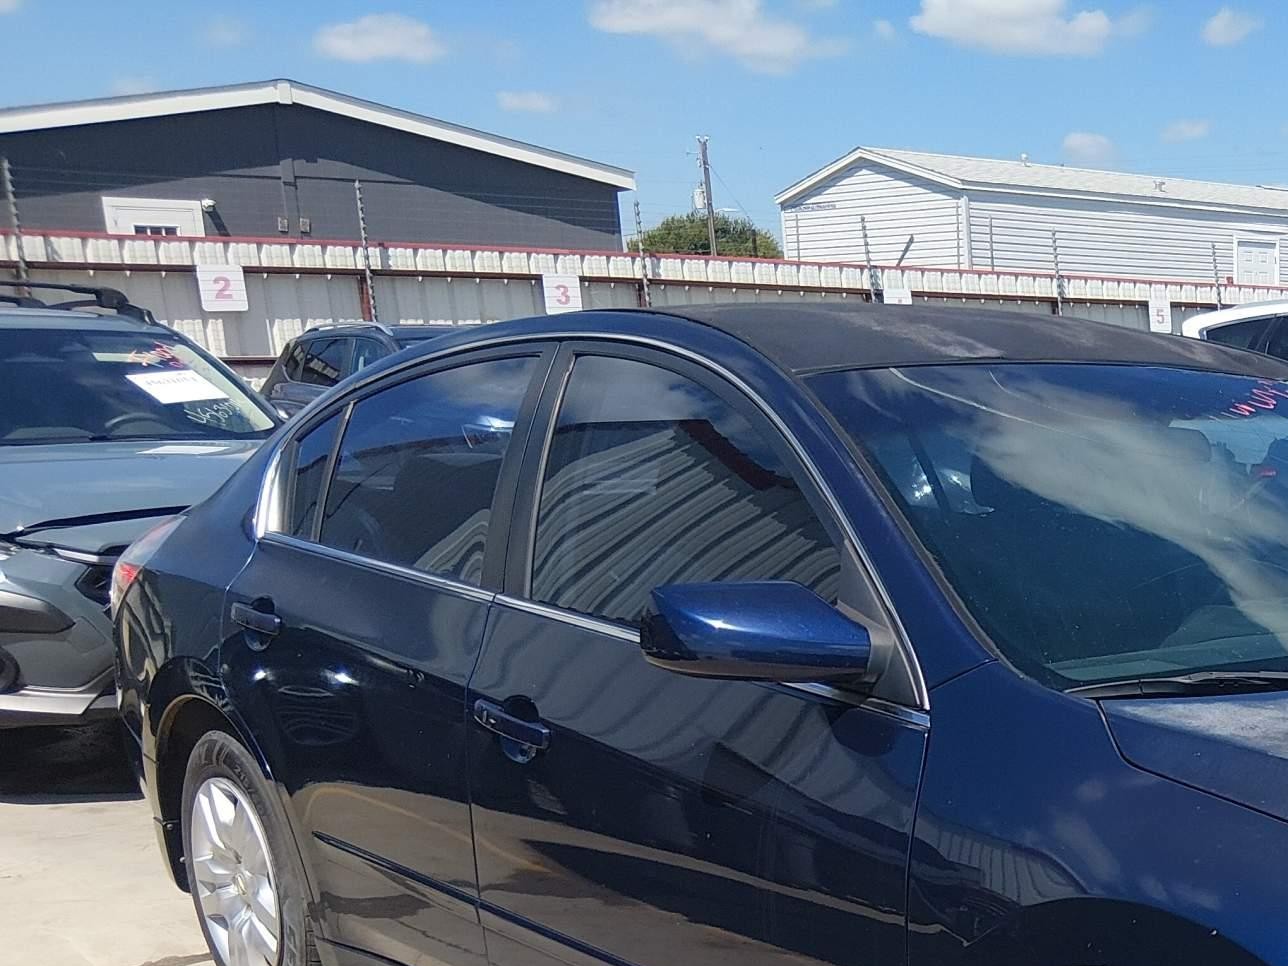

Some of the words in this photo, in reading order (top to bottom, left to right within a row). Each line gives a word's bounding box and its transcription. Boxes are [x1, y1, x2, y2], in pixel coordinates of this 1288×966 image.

[213, 276, 233, 300] 2
[554, 284, 570, 306] 3
[1156, 308, 1165, 324] 5
